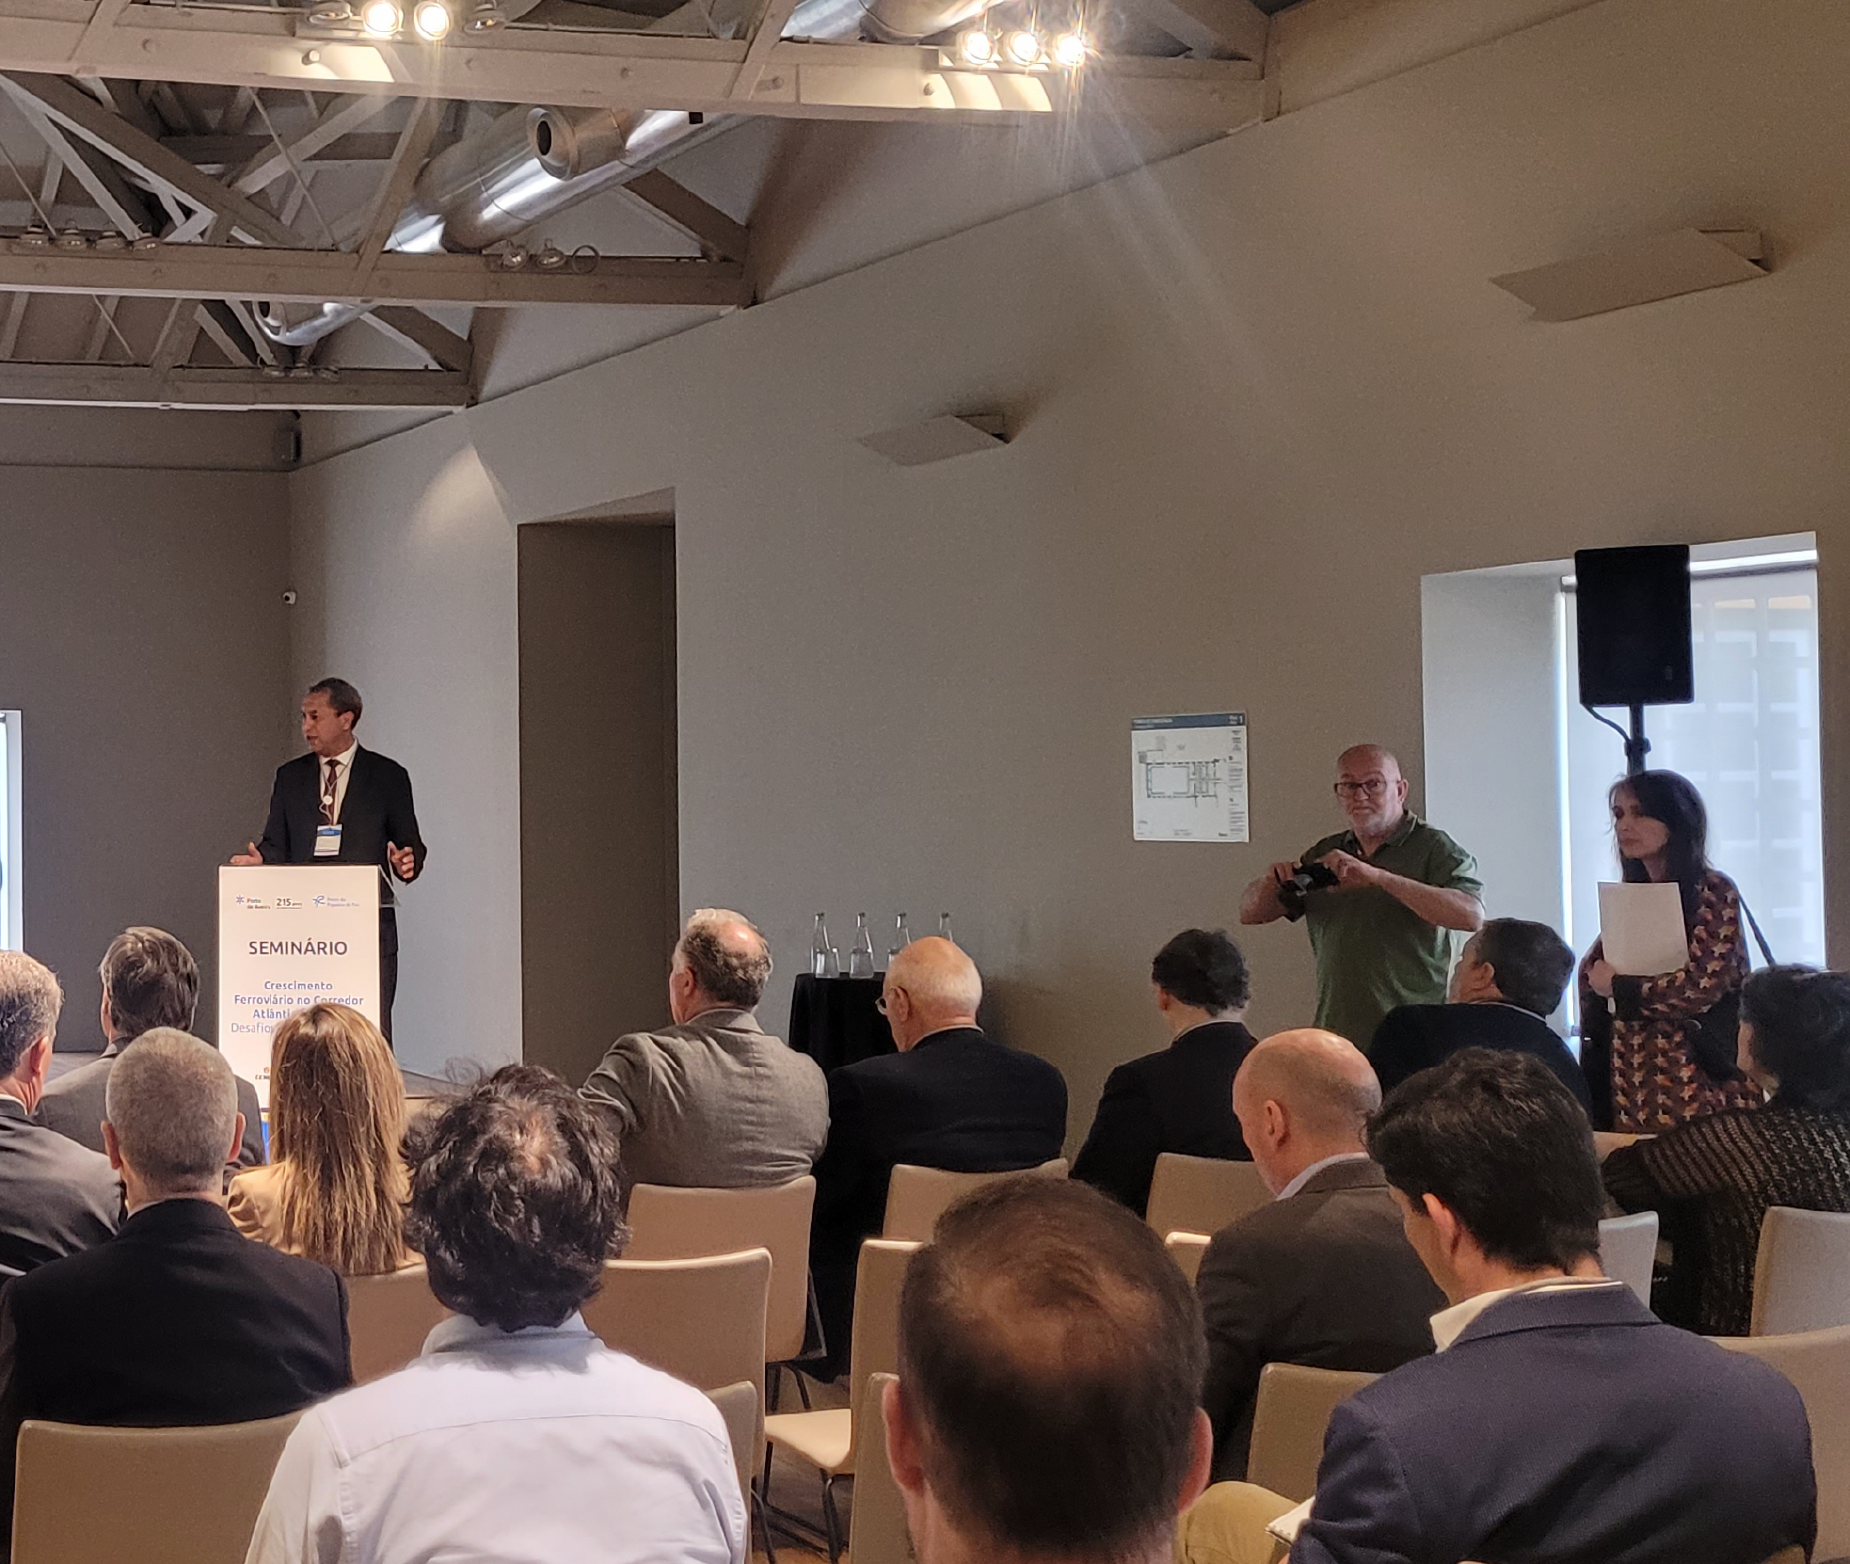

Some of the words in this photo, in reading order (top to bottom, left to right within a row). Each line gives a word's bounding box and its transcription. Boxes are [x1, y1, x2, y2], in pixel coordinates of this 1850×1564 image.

[276, 898, 292, 906] 215
[248, 937, 348, 956] SEMINÁRIO
[264, 980, 334, 991] Crescimento
[234, 994, 294, 1005] Ferroviário
[296, 997, 311, 1005] no
[314, 995, 364, 1005] Corredor
[253, 1008, 291, 1019] Atlânti
[231, 1022, 274, 1034] Desafio
